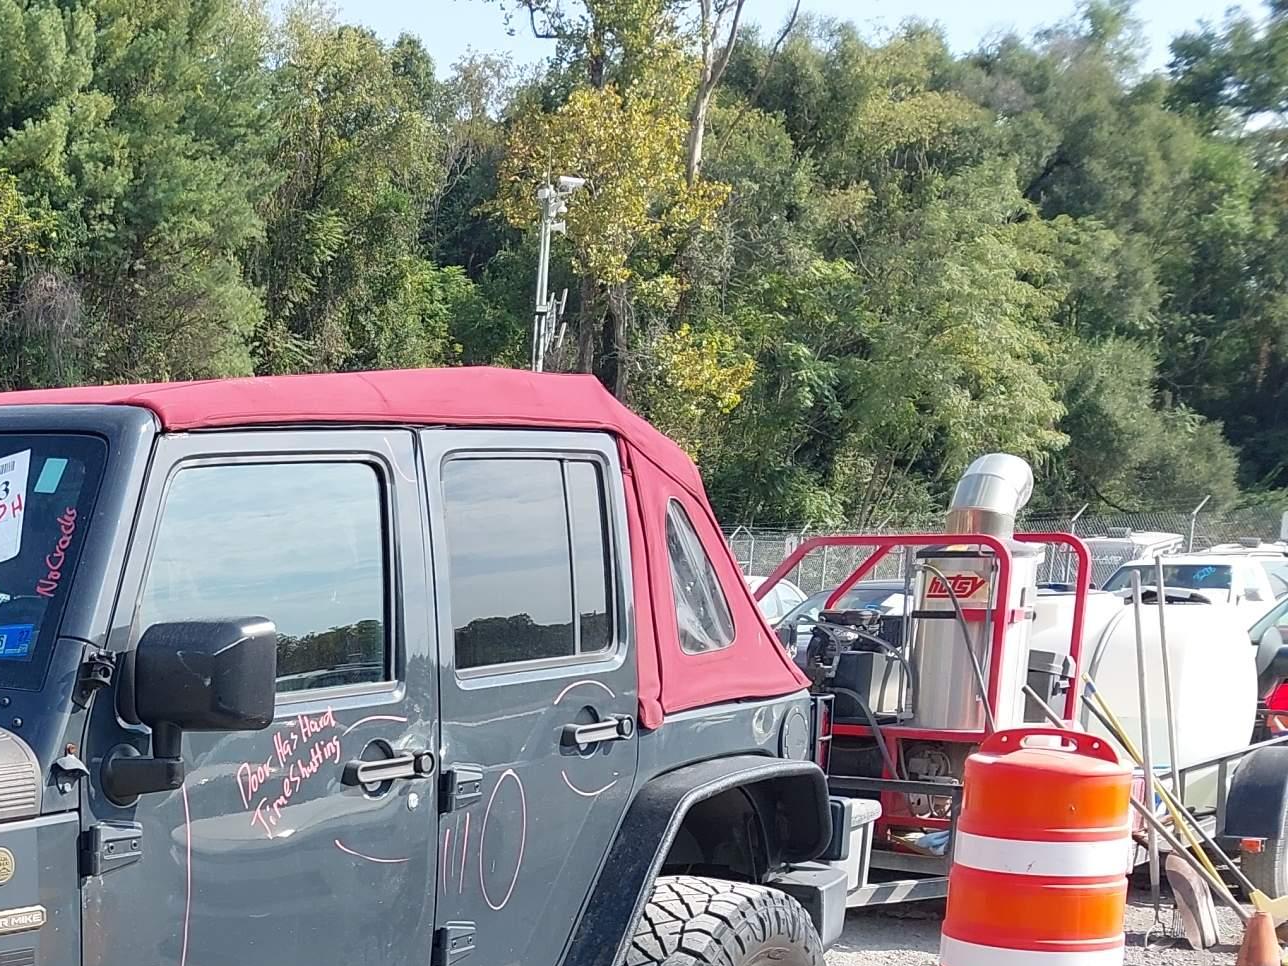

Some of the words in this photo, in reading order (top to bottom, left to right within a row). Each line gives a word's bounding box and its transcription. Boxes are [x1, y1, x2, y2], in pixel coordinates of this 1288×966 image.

[237, 755, 273, 809] Door
[273, 731, 298, 768] Has
[297, 705, 336, 743] Hard
[11, 912, 41, 925] MIKE
